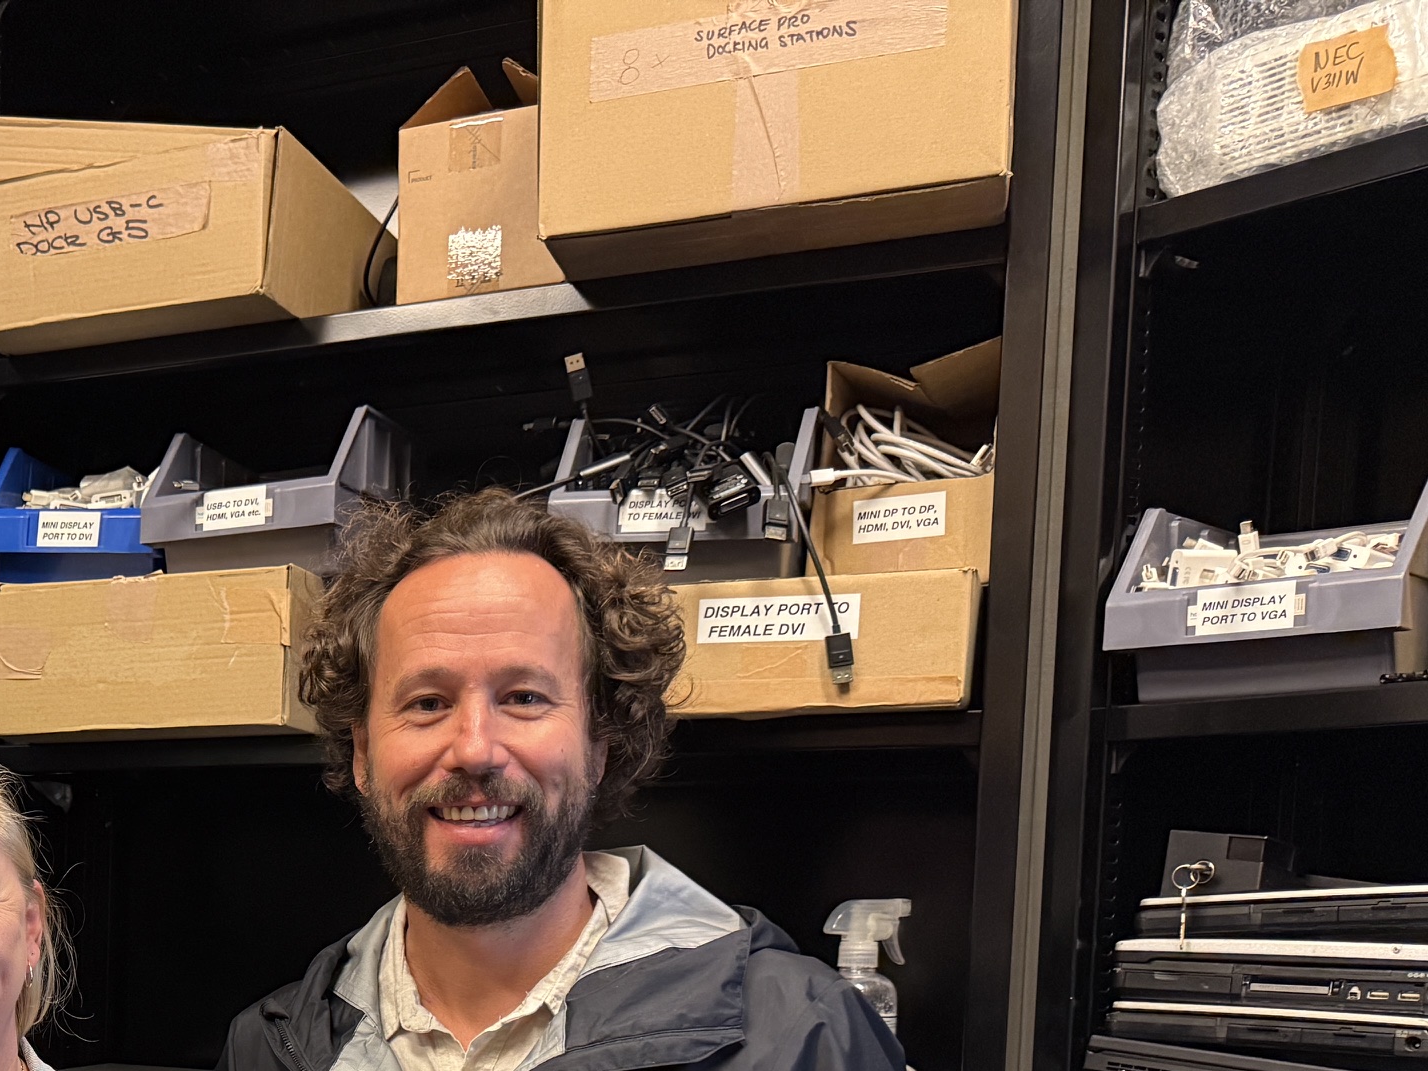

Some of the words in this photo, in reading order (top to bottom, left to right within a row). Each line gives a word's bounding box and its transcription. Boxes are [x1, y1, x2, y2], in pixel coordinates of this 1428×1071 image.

[694, 18, 772, 42] SURFACE
[777, 13, 811, 31] PRO
[706, 37, 769, 60] DOCKING
[779, 20, 858, 48] STATIONS
[1314, 41, 1365, 73] NEC
[23, 210, 61, 236] HP
[74, 194, 164, 225] USB-C
[16, 233, 87, 256] DOCK
[97, 219, 149, 244] G5
[206, 500, 232, 511] USB-C
[232, 499, 243, 509] TO
[244, 498, 260, 508] DVI,
[628, 500, 669, 509] DISPLAY
[857, 510, 881, 521] MINI
[883, 508, 899, 518] DP
[901, 506, 916, 516] TO
[918, 504, 937, 514] DP,
[205, 512, 229, 522] HDMI,
[230, 510, 246, 519] VGA
[248, 509, 262, 517] etc.
[628, 513, 640, 521] TO
[642, 512, 683, 520] FEMALE
[41, 521, 59, 529] MINI
[60, 521, 95, 530] DISPLAY
[858, 523, 889, 534] HDMI,
[891, 520, 912, 530] DVI,
[916, 517, 939, 528] VGA
[42, 532, 65, 541] PORT
[66, 532, 77, 541] TO
[78, 533, 93, 541] DVI
[704, 604, 774, 618] DISPLAY
[777, 602, 824, 616] PORT
[1201, 600, 1229, 612] MINI
[1231, 594, 1287, 609] DISPLAY
[1201, 613, 1238, 626] PORT
[1240, 612, 1257, 622] TO
[1261, 609, 1287, 620] VGA
[708, 624, 774, 638] FEMALE
[778, 623, 806, 636] DVI
